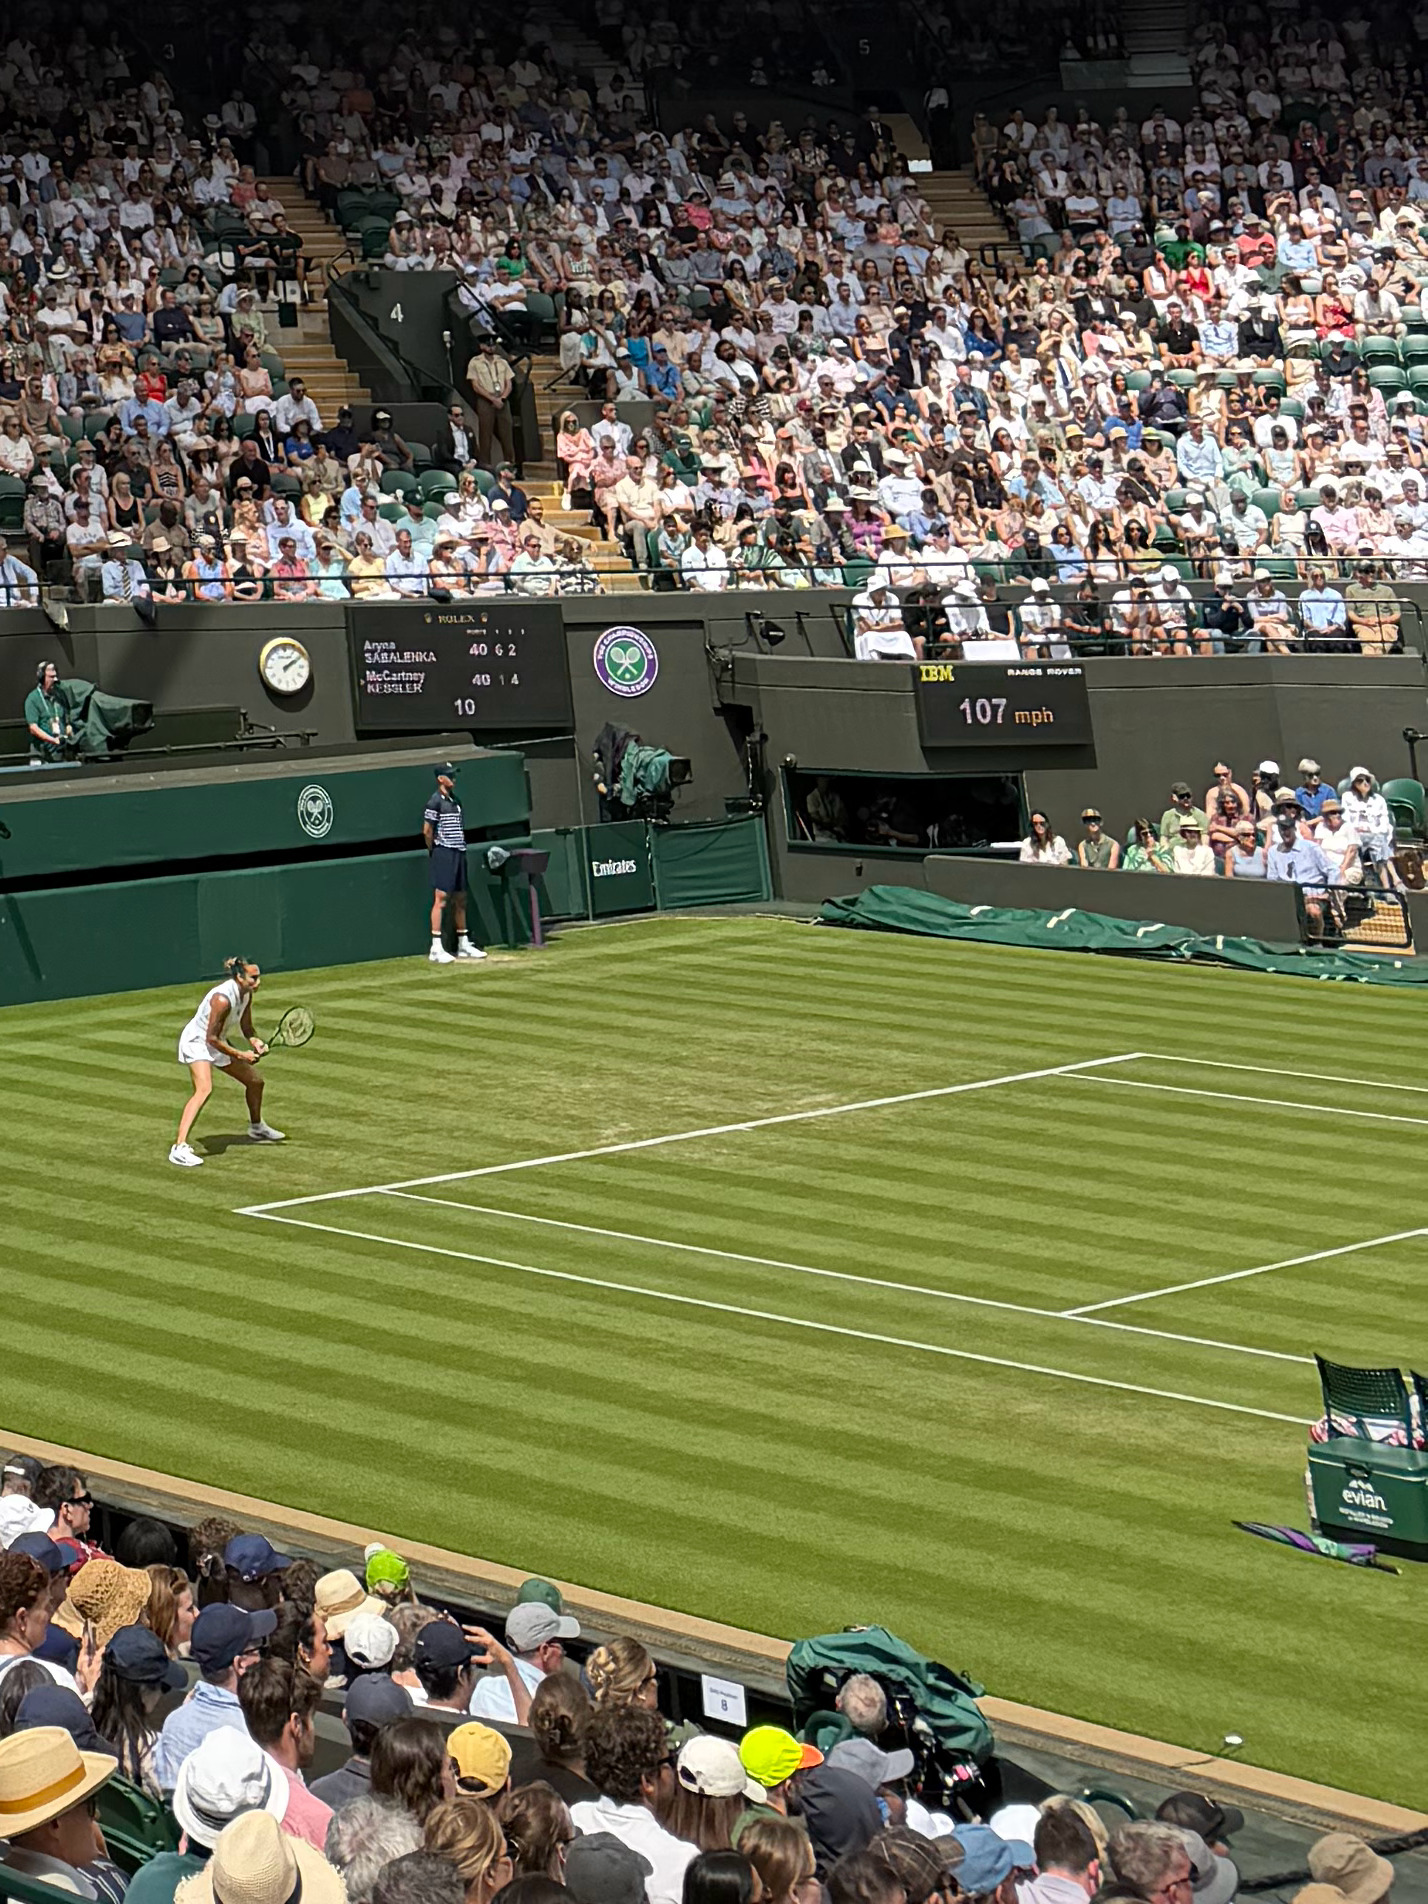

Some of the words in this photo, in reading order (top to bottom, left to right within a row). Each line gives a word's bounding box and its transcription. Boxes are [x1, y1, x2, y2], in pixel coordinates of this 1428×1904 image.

[859, 39, 870, 55] 5
[390, 302, 404, 323] 4
[438, 614, 476, 624] ROLEX
[364, 640, 396, 652] Aryna
[469, 643, 488, 656] 40
[495, 643, 504, 656] 6
[508, 643, 517, 656] 2
[364, 651, 437, 663] SABALENKA
[366, 670, 425, 684] McCartney
[920, 665, 955, 682] IBM
[1007, 668, 1043, 676] RANGE
[1047, 667, 1083, 676] ROVER
[472, 674, 491, 686] 40
[499, 674, 505, 686] 1
[511, 673, 519, 685] 4
[367, 683, 423, 693] KESSLER
[454, 697, 476, 716] 10
[959, 697, 1007, 725] 107
[1014, 707, 1055, 727] mph
[592, 859, 637, 877] Emirates
[1342, 1489, 1388, 1511] evian
[721, 1698, 728, 1712] 8
